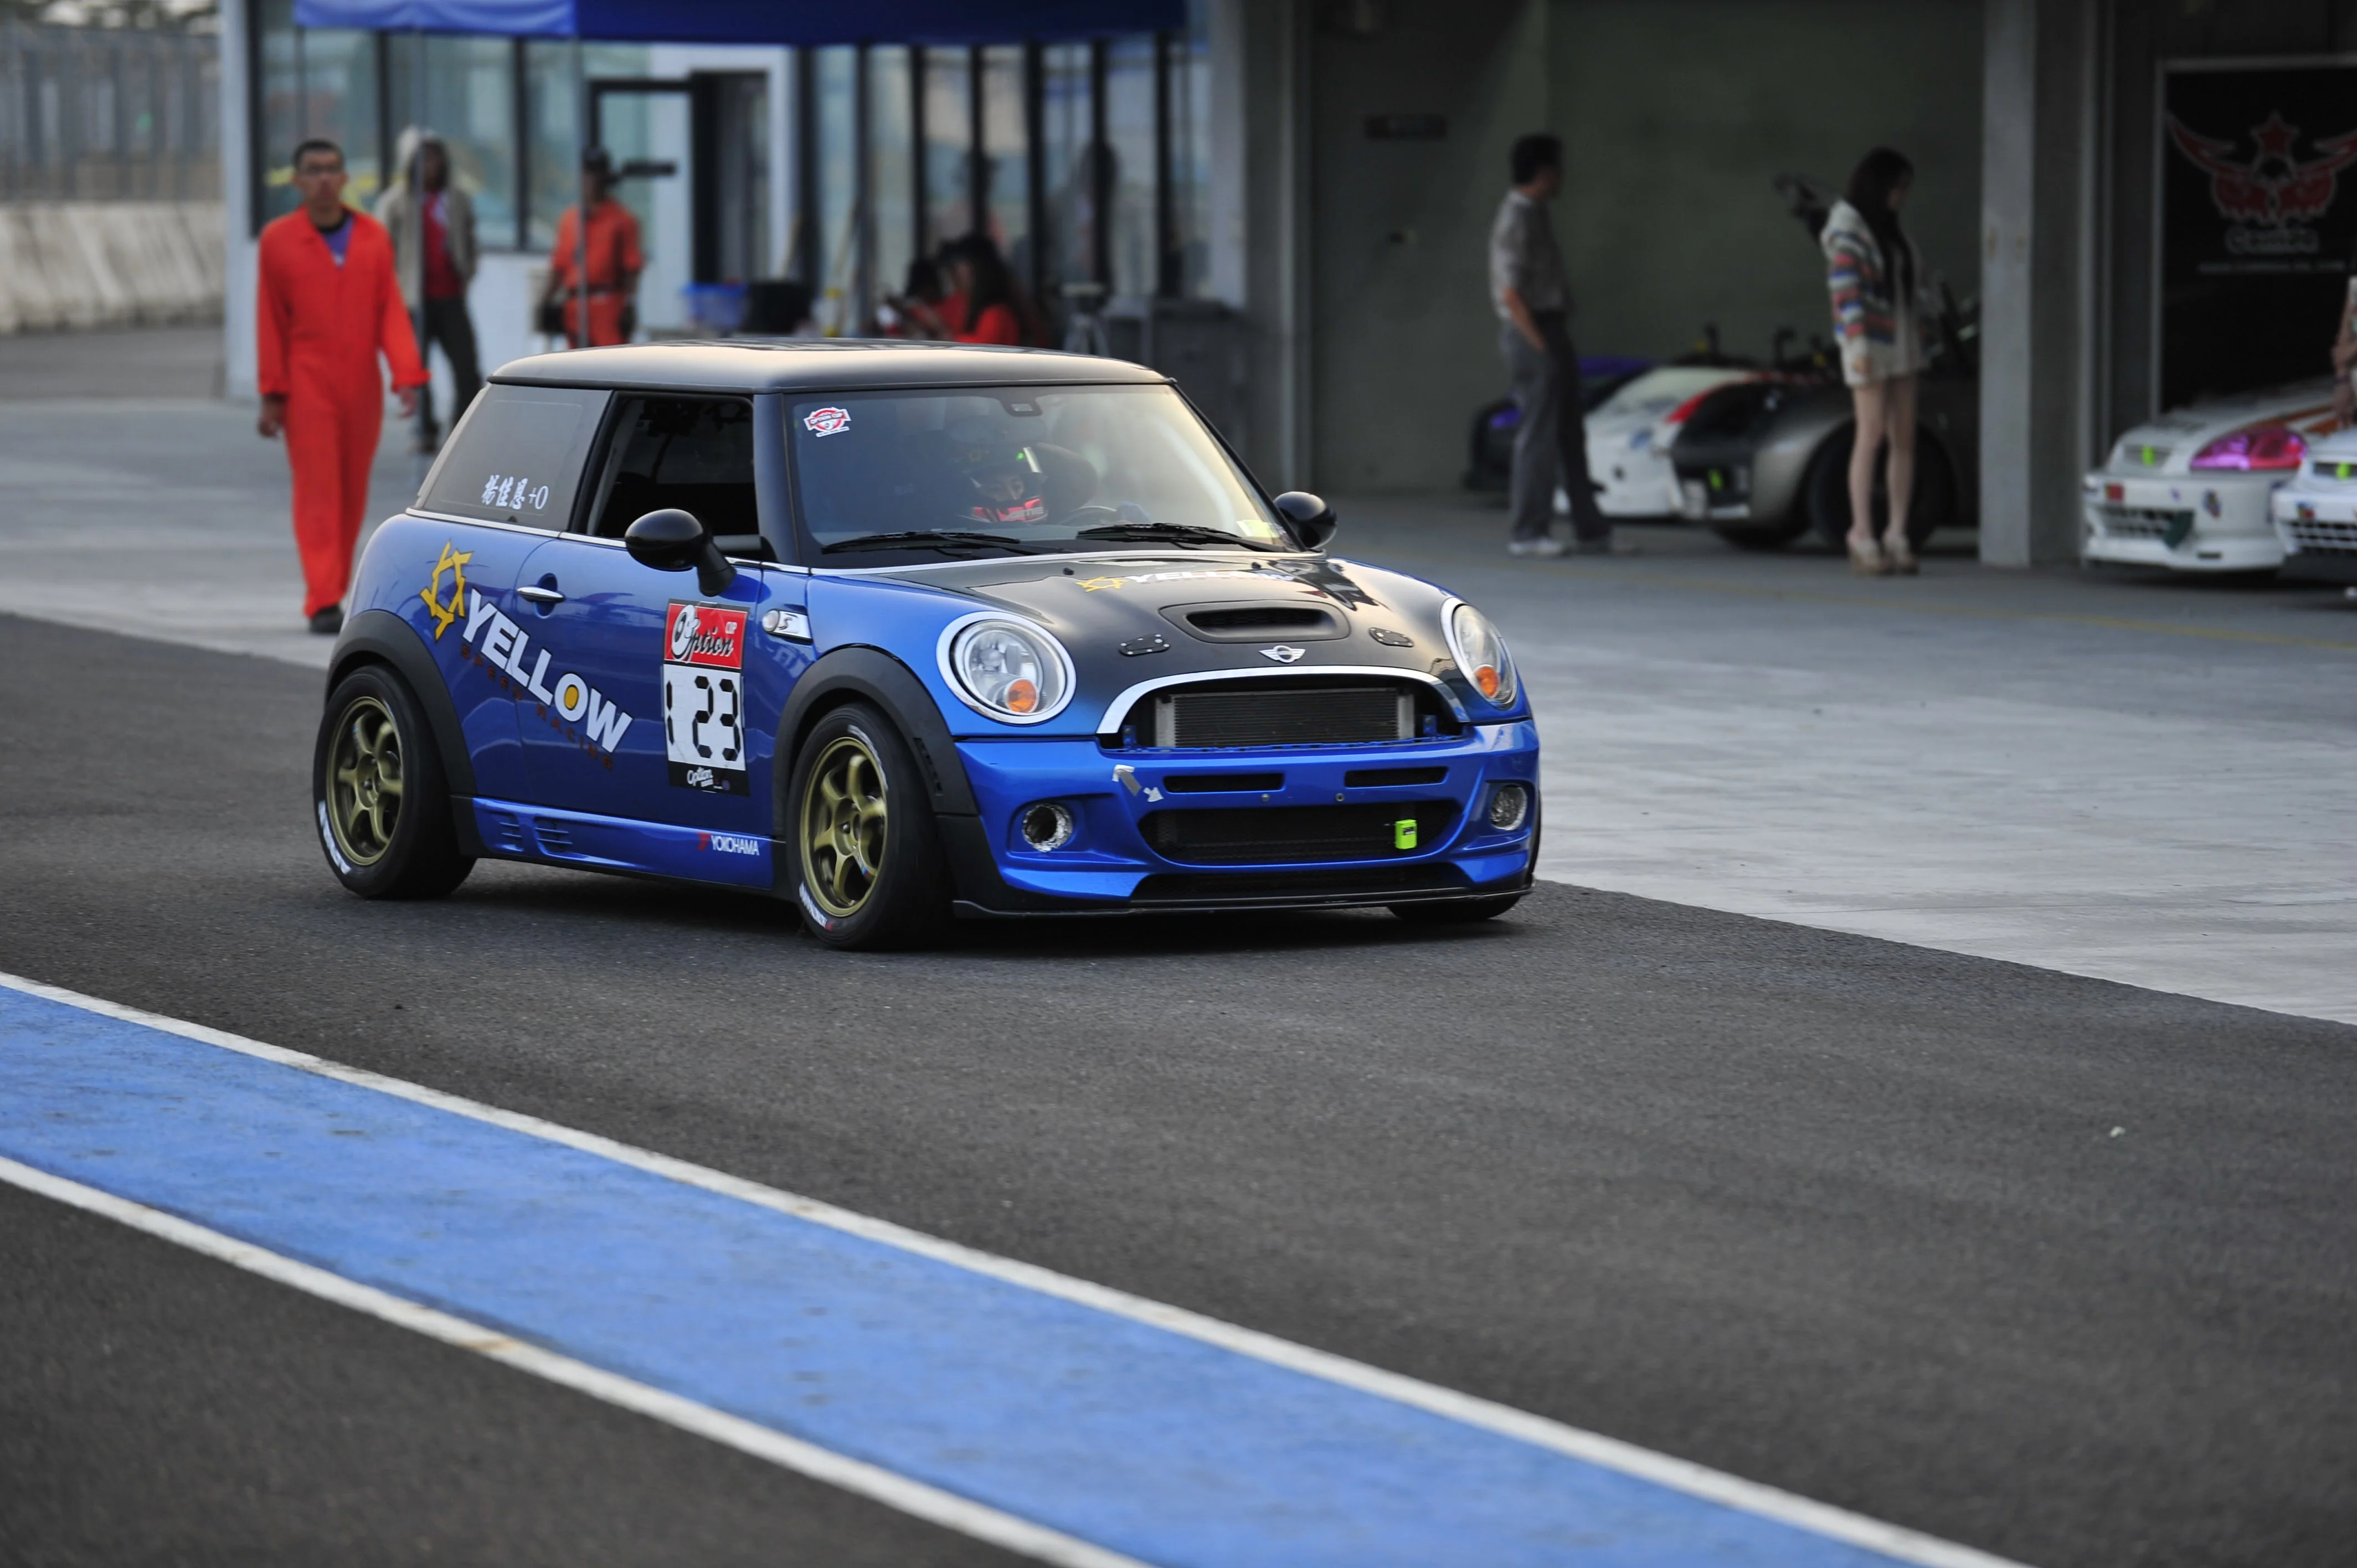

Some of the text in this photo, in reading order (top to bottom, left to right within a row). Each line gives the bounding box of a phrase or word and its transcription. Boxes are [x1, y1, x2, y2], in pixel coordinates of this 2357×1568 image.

[461, 644, 613, 770] SPEED RACING
[462, 588, 633, 753] YELLOW
[666, 675, 741, 761] 123
[711, 835, 760, 856] YOKOHAMA
